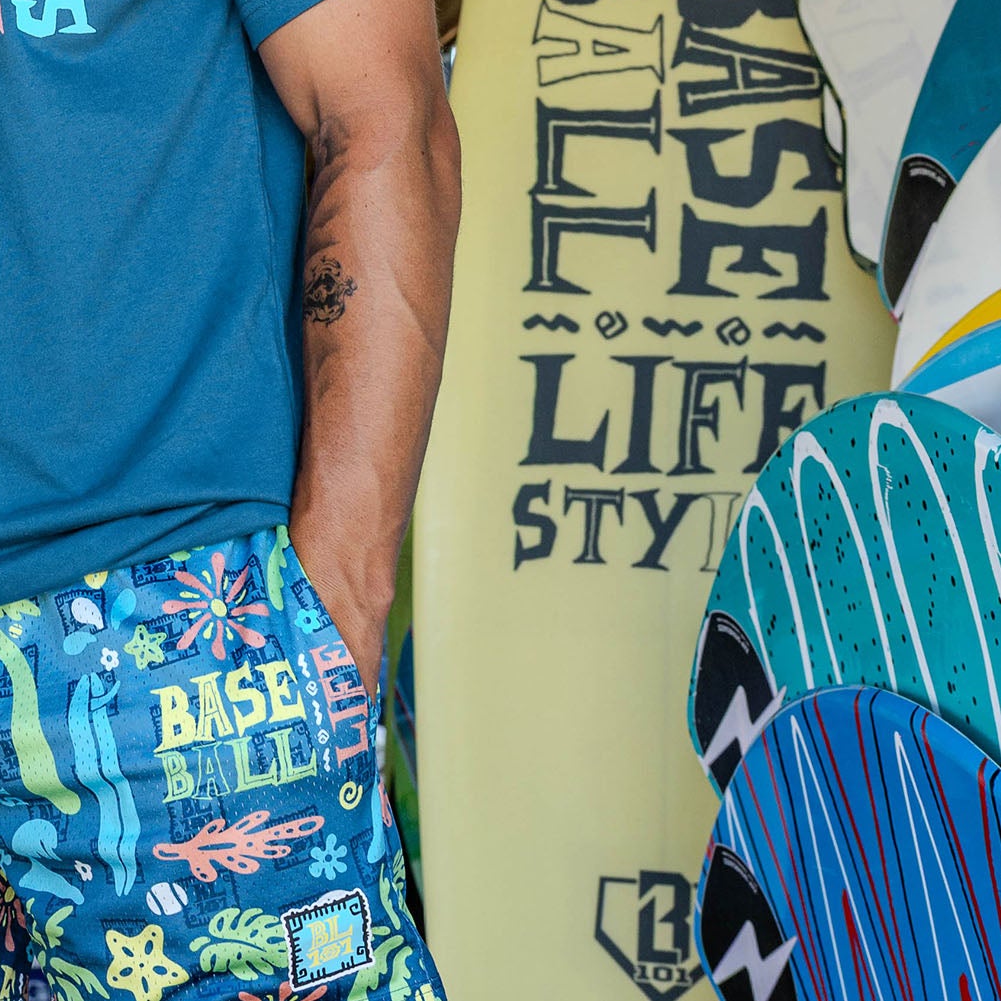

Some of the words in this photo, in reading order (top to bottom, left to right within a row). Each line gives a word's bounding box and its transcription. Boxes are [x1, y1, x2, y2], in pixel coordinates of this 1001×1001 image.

[150, 658, 306, 755] BASE
[309, 640, 368, 769] LIFE
[153, 723, 318, 804] BALL
[306, 915, 353, 952] BL
[632, 964, 693, 988] 101
